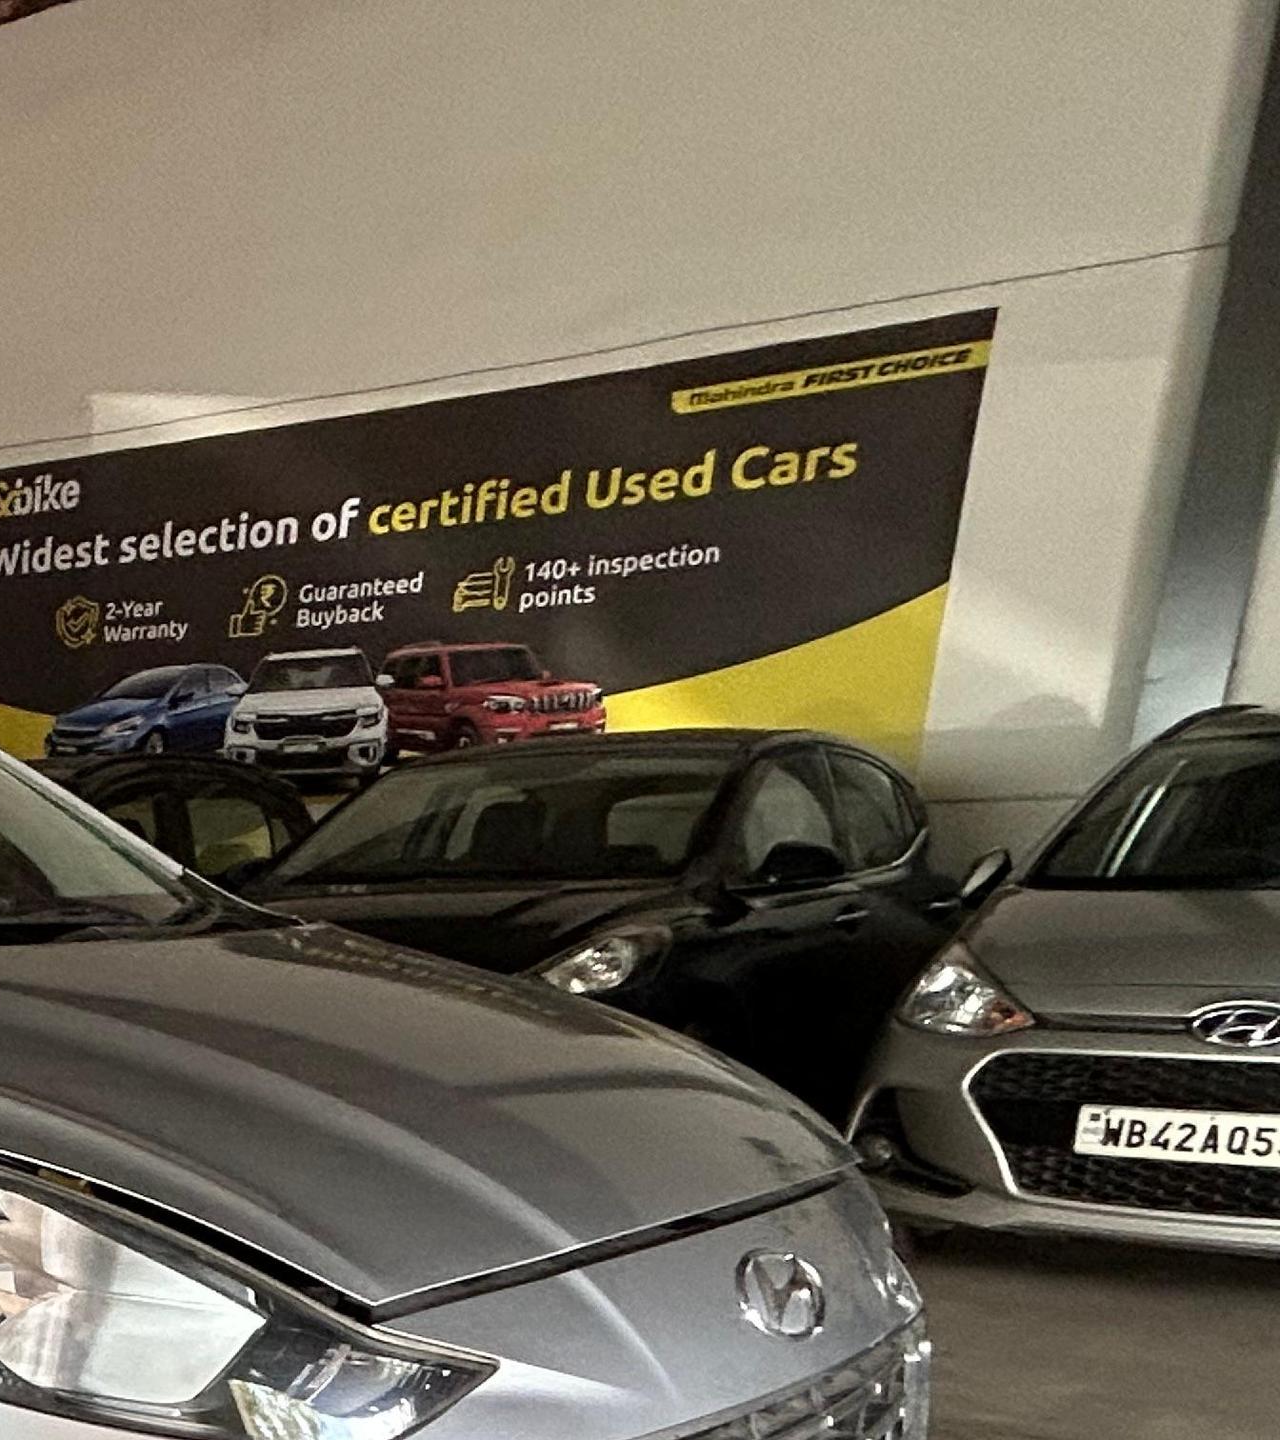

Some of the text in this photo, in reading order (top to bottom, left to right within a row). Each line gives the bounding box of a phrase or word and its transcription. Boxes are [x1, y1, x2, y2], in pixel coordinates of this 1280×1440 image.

[689, 347, 973, 406] Mahindra FIRST CHOICE
[118, 511, 299, 565] selection
[311, 497, 361, 543] of
[368, 469, 573, 536] certified
[585, 449, 717, 512] Used
[730, 442, 859, 491] Cars
[524, 543, 721, 582] 140+ inspection
[299, 571, 425, 604] Guaranteed
[518, 583, 597, 613] points
[105, 600, 163, 620] 2-Year
[296, 601, 384, 631] Buyback
[103, 619, 189, 644] Warranty
[1099, 1116, 1280, 1158] WB42AQ5
